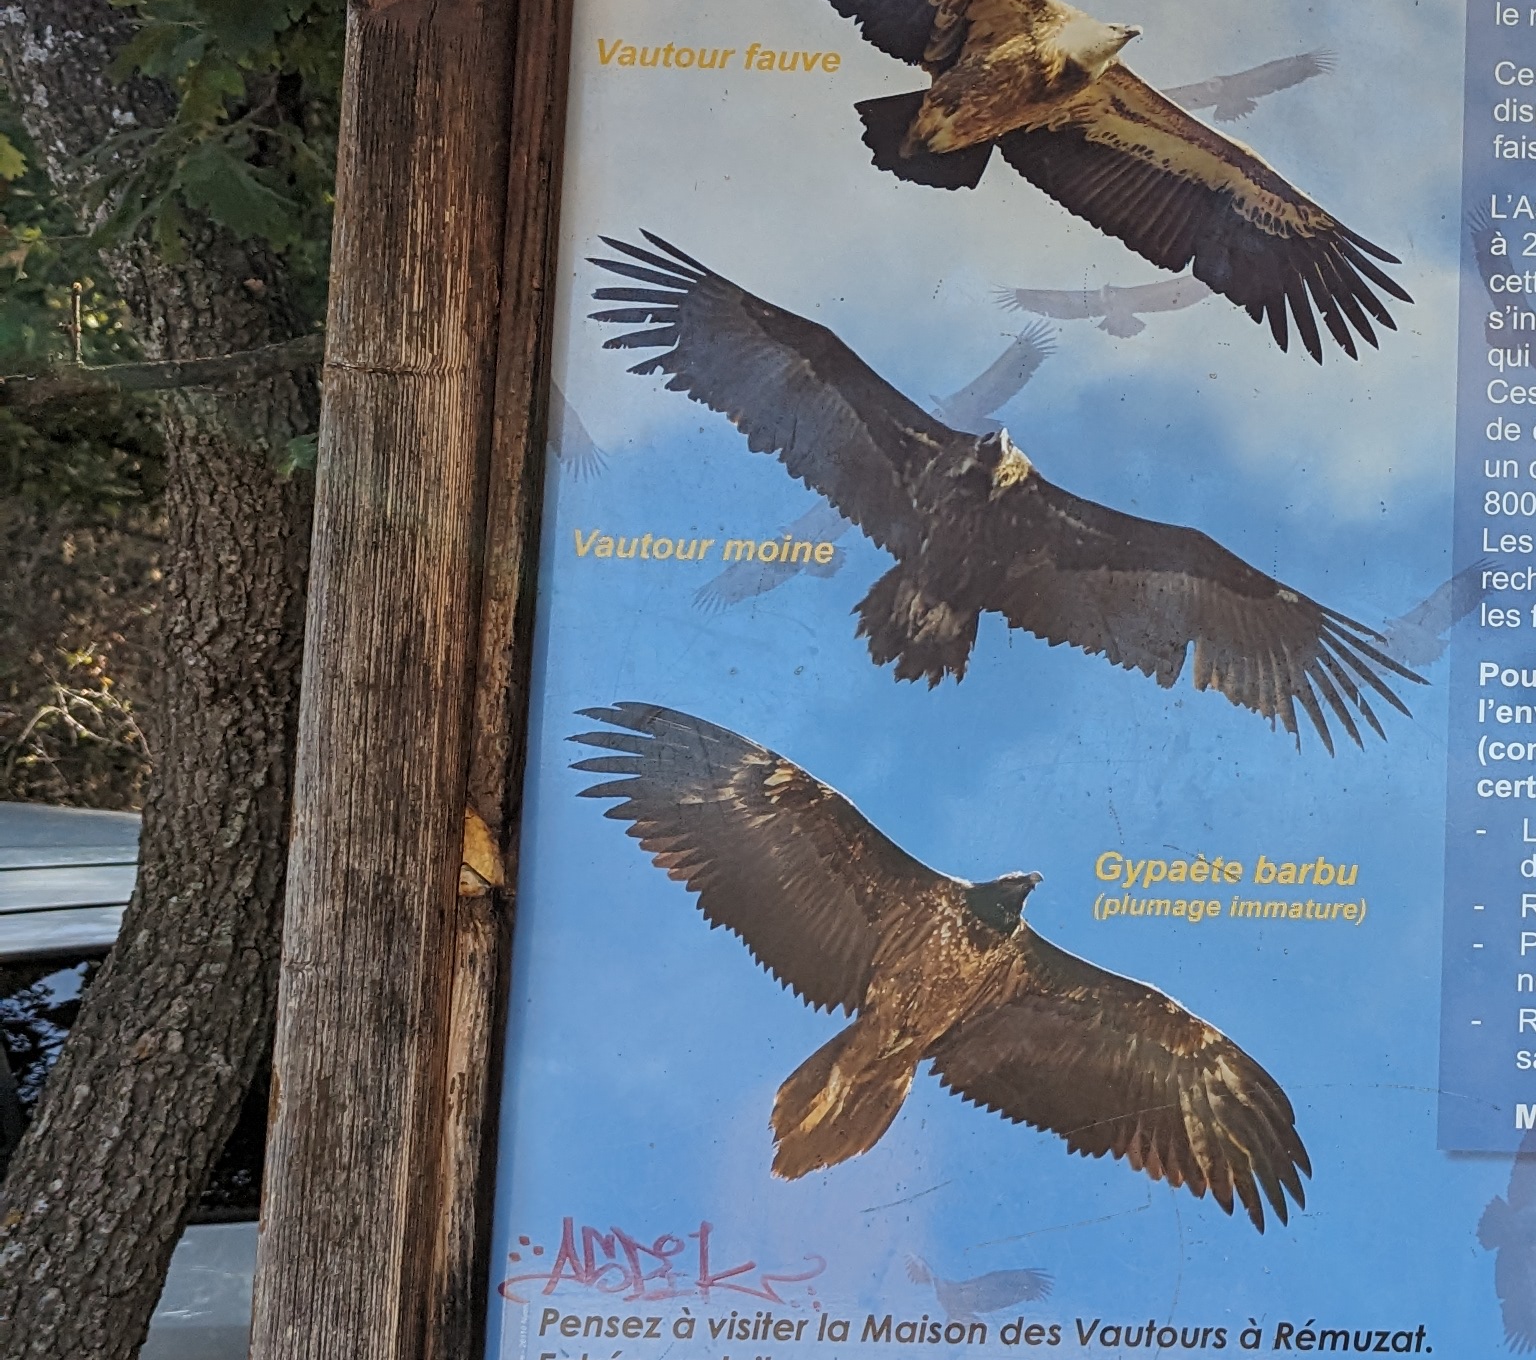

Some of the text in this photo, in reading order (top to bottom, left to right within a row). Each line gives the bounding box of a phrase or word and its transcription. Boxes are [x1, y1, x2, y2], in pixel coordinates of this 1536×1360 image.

[1496, 1, 1519, 26] le
[597, 38, 842, 74] Vautour fauve
[573, 528, 836, 566] Vautour moine
[1094, 850, 1359, 892] Gypaète barbu
[1091, 892, 1368, 926] (plumage immature)
[538, 1306, 1433, 1354] Pensez à visiter la Maison des Vautours à Rémuzat.
